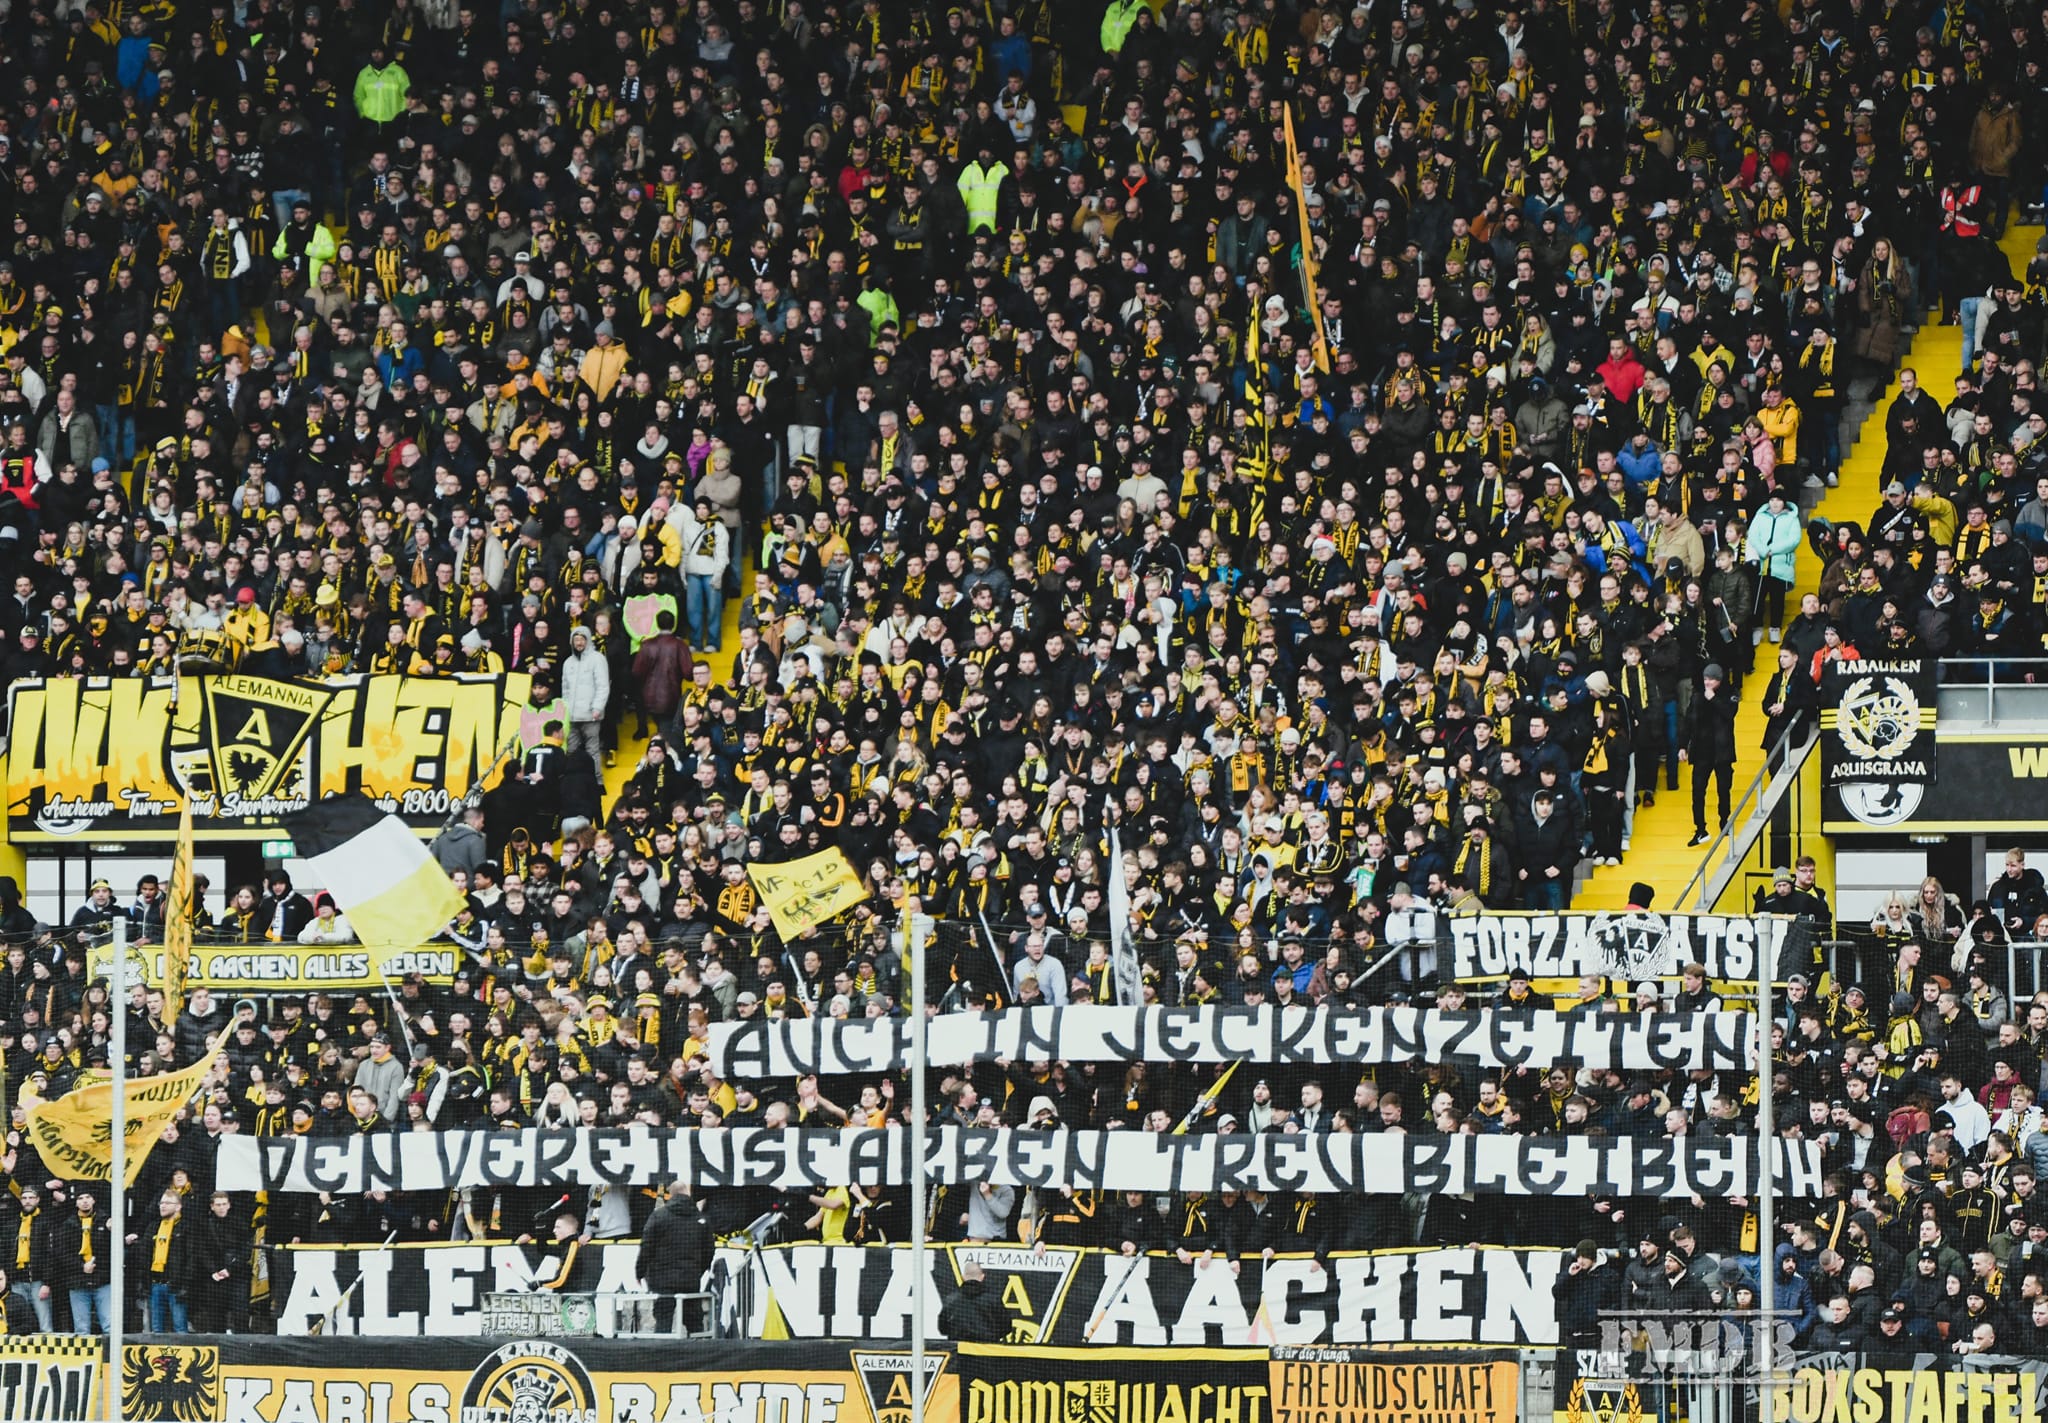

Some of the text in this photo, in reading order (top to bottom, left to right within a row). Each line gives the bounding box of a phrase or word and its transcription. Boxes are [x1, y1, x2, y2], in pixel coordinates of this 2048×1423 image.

[1837, 659, 1921, 675] RABAUKEN
[213, 676, 314, 708] ALEMANNIA
[236, 708, 272, 746] A
[1831, 761, 1927, 778] AQUISGRANA
[42, 794, 115, 818] Aachener
[119, 788, 176, 819] Turn-
[402, 789, 448, 813] 1900
[1451, 915, 1789, 981] FORZA ATSV
[209, 955, 298, 980] AACHEN
[304, 953, 369, 979] ALLES
[723, 1003, 1749, 1078] AUCH IN JECKENZEITEN
[255, 1134, 402, 1193] DEN
[435, 1127, 1107, 1192] VEREINSFARBEN
[1157, 1131, 1364, 1193] TREU
[964, 1252, 1066, 1268] ALEMANNIA
[1002, 1274, 1034, 1316] A
[1083, 1249, 1560, 1345] AACHEN
[497, 1342, 568, 1364] KARLS
[861, 1356, 936, 1370] ALEMANIA
[1576, 1350, 1630, 1379] SZENE
[224, 1377, 846, 1422] KARLS BANDE
[885, 1374, 912, 1405] A
[969, 1378, 1268, 1422] DOM WACHT
[1281, 1362, 1494, 1411] FREUNDSCHAFT
[1758, 1367, 2042, 1422] BOXSTAFFEL
